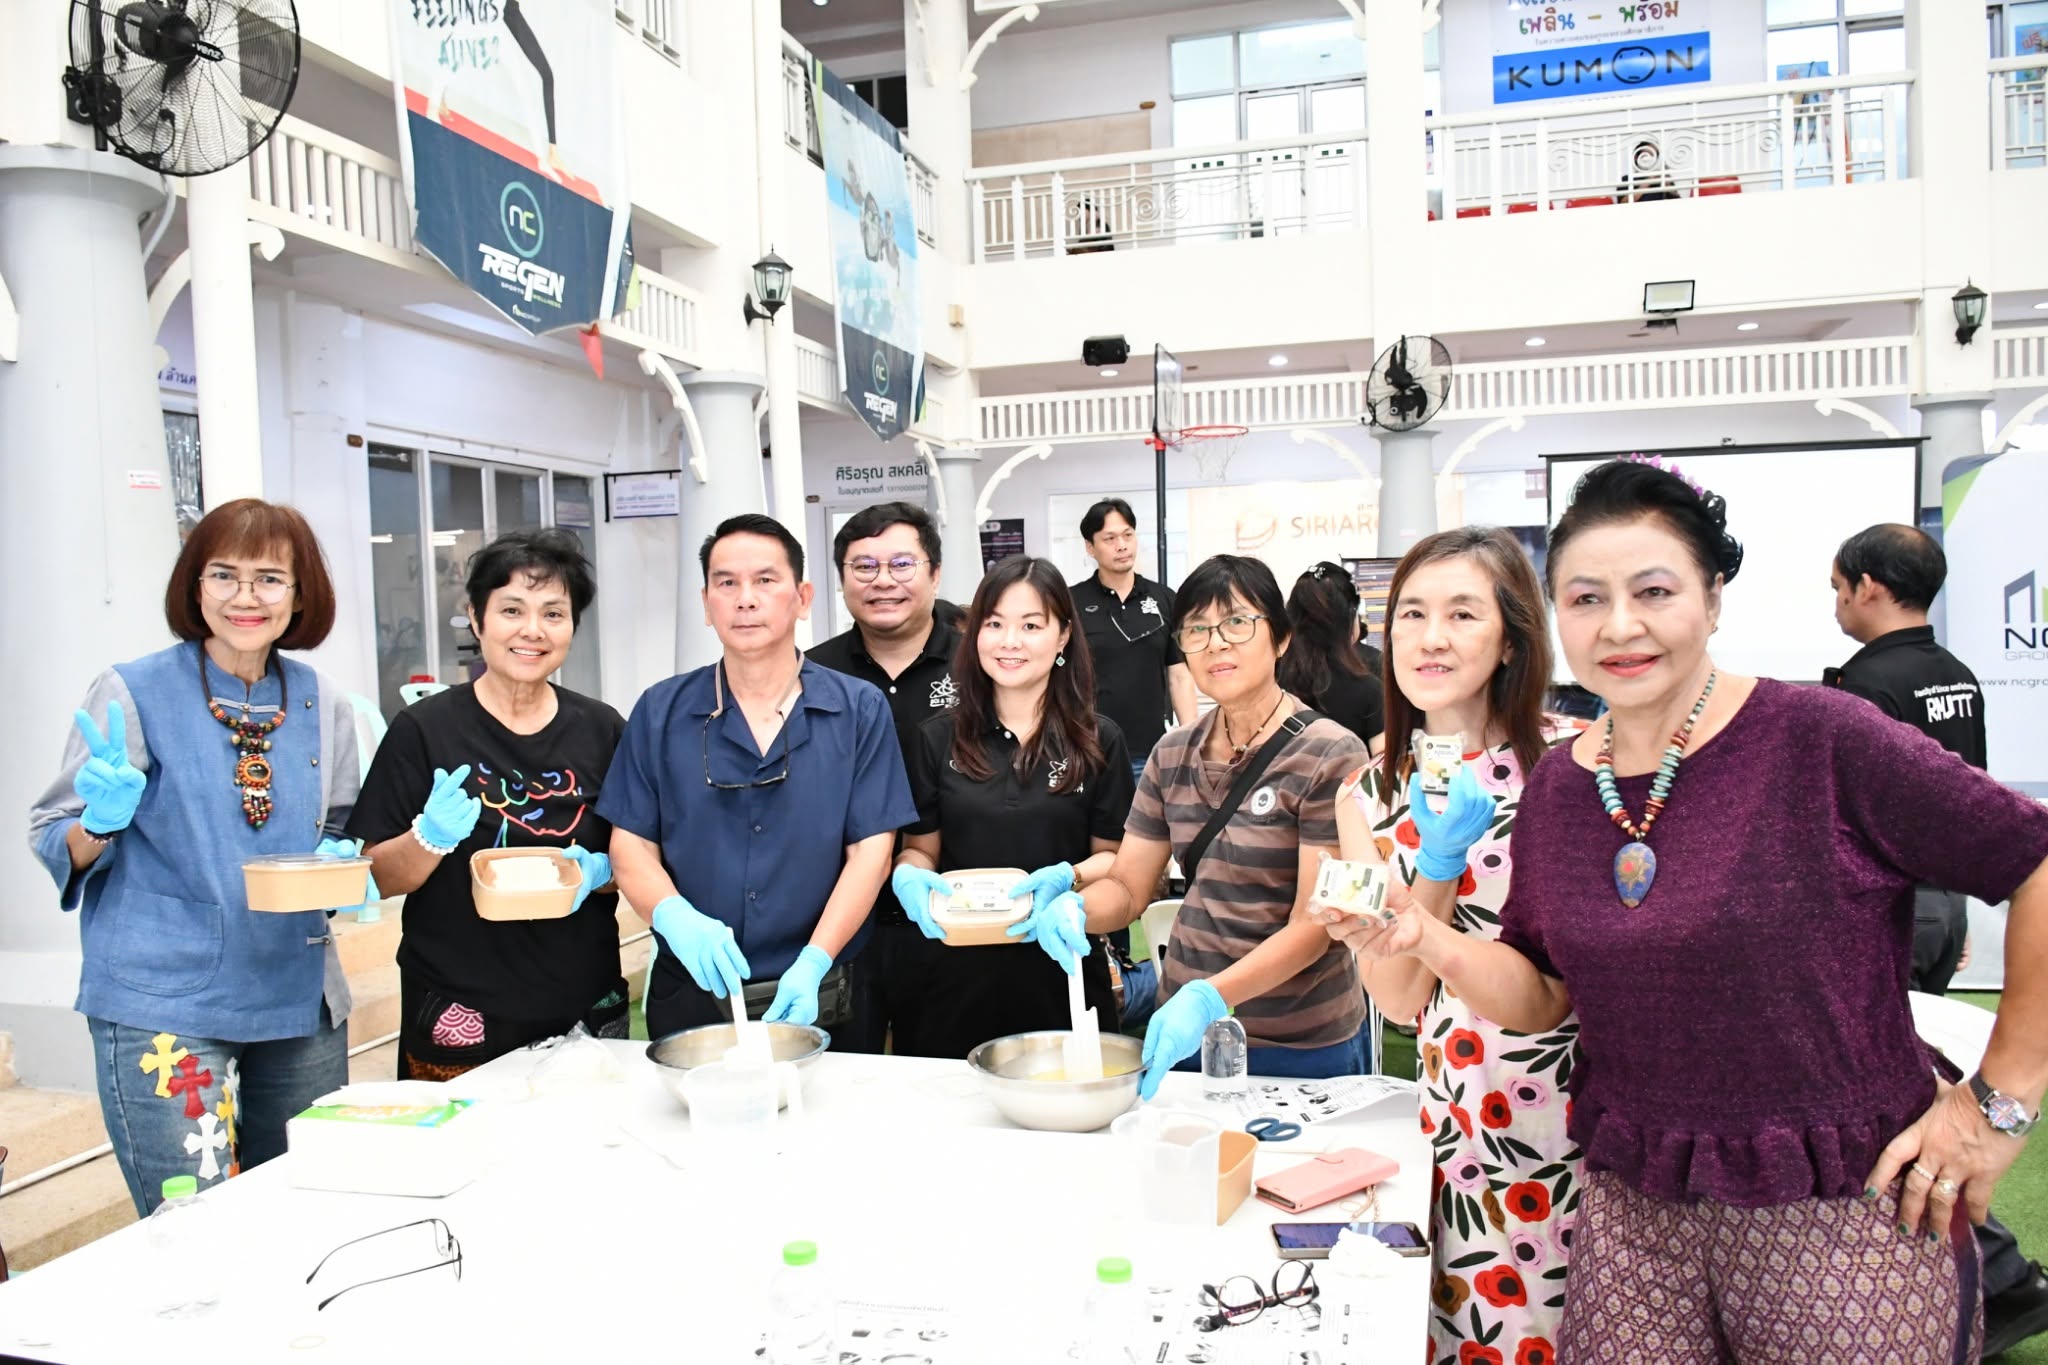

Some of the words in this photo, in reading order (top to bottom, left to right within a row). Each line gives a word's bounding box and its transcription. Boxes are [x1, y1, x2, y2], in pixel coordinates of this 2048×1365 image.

[1508, 46, 1694, 91] KUMON
[478, 242, 566, 303] REGEN
[1291, 513, 1380, 538] SIRIAR
